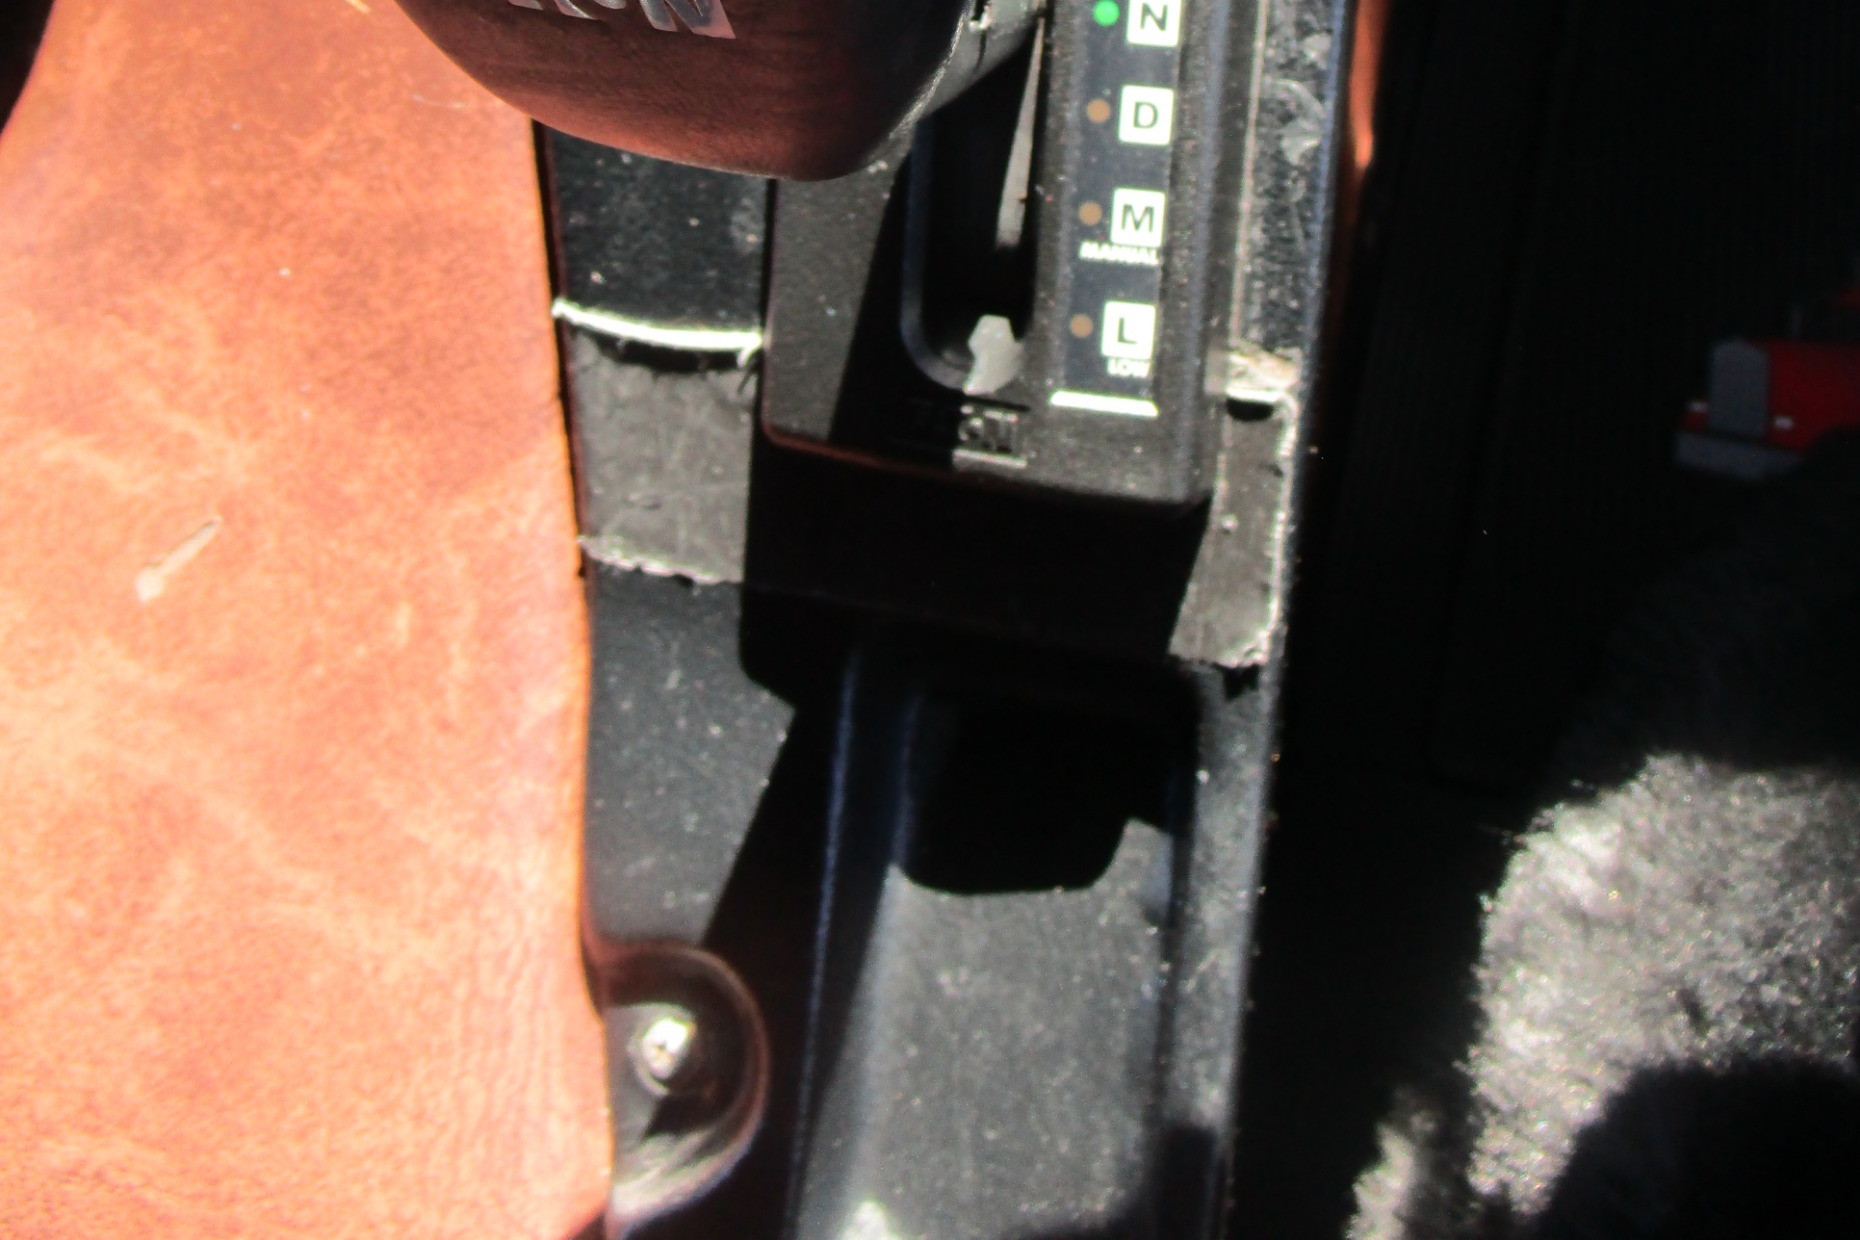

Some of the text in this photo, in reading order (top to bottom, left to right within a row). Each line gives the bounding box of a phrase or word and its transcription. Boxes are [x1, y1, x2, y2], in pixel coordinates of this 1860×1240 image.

[1139, 1, 1169, 33] N
[1132, 100, 1159, 130] D
[1120, 203, 1155, 233] M
[1079, 240, 1159, 266] MANUAL
[1116, 316, 1138, 346] L
[1107, 359, 1150, 378] LOW
